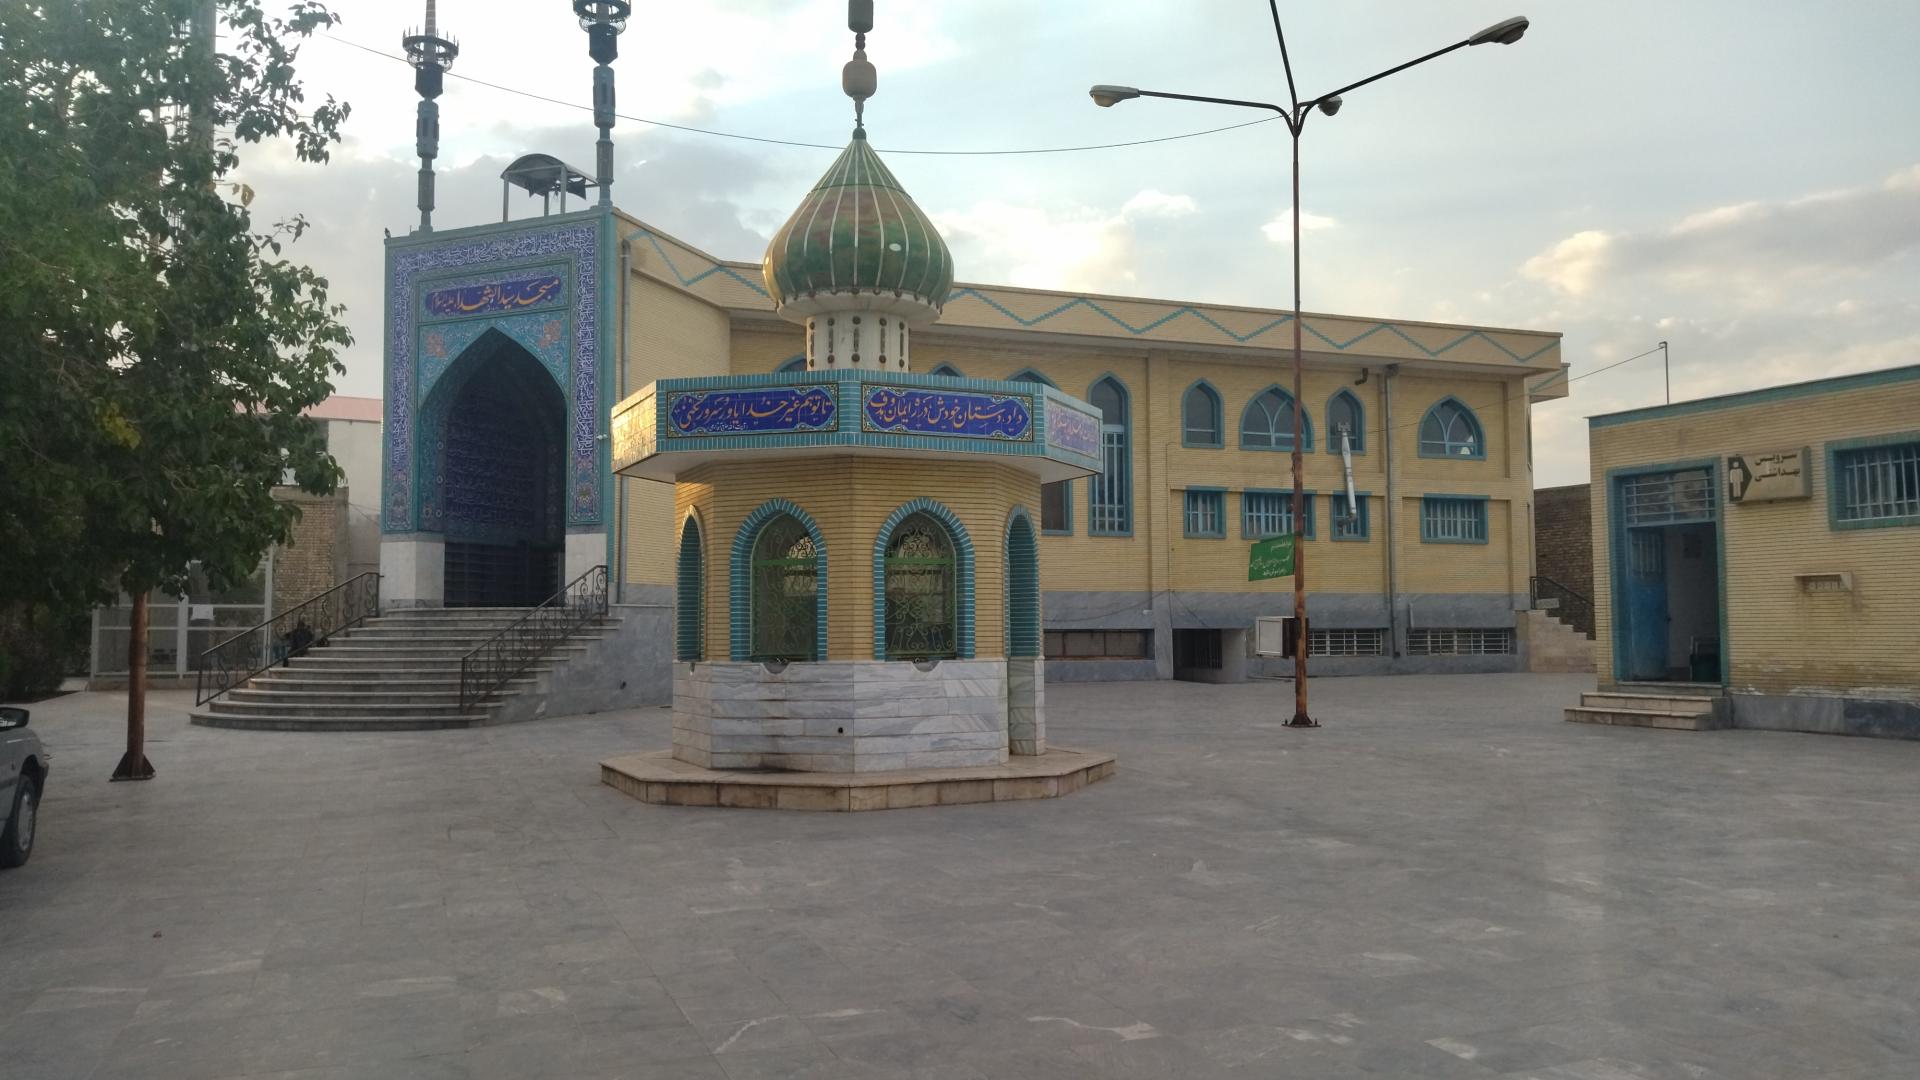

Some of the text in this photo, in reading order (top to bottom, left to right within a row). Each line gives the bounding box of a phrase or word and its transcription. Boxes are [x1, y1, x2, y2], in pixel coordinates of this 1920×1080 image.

[513, 279, 559, 304] مسجد
[742, 399, 789, 418] خدا
[776, 396, 800, 423] غیر
[821, 398, 832, 415] تا
[884, 399, 911, 423] ایمان
[928, 396, 961, 425] خودش
[1754, 453, 1798, 466] سرویس
[1754, 466, 1801, 482] بهداشتی
